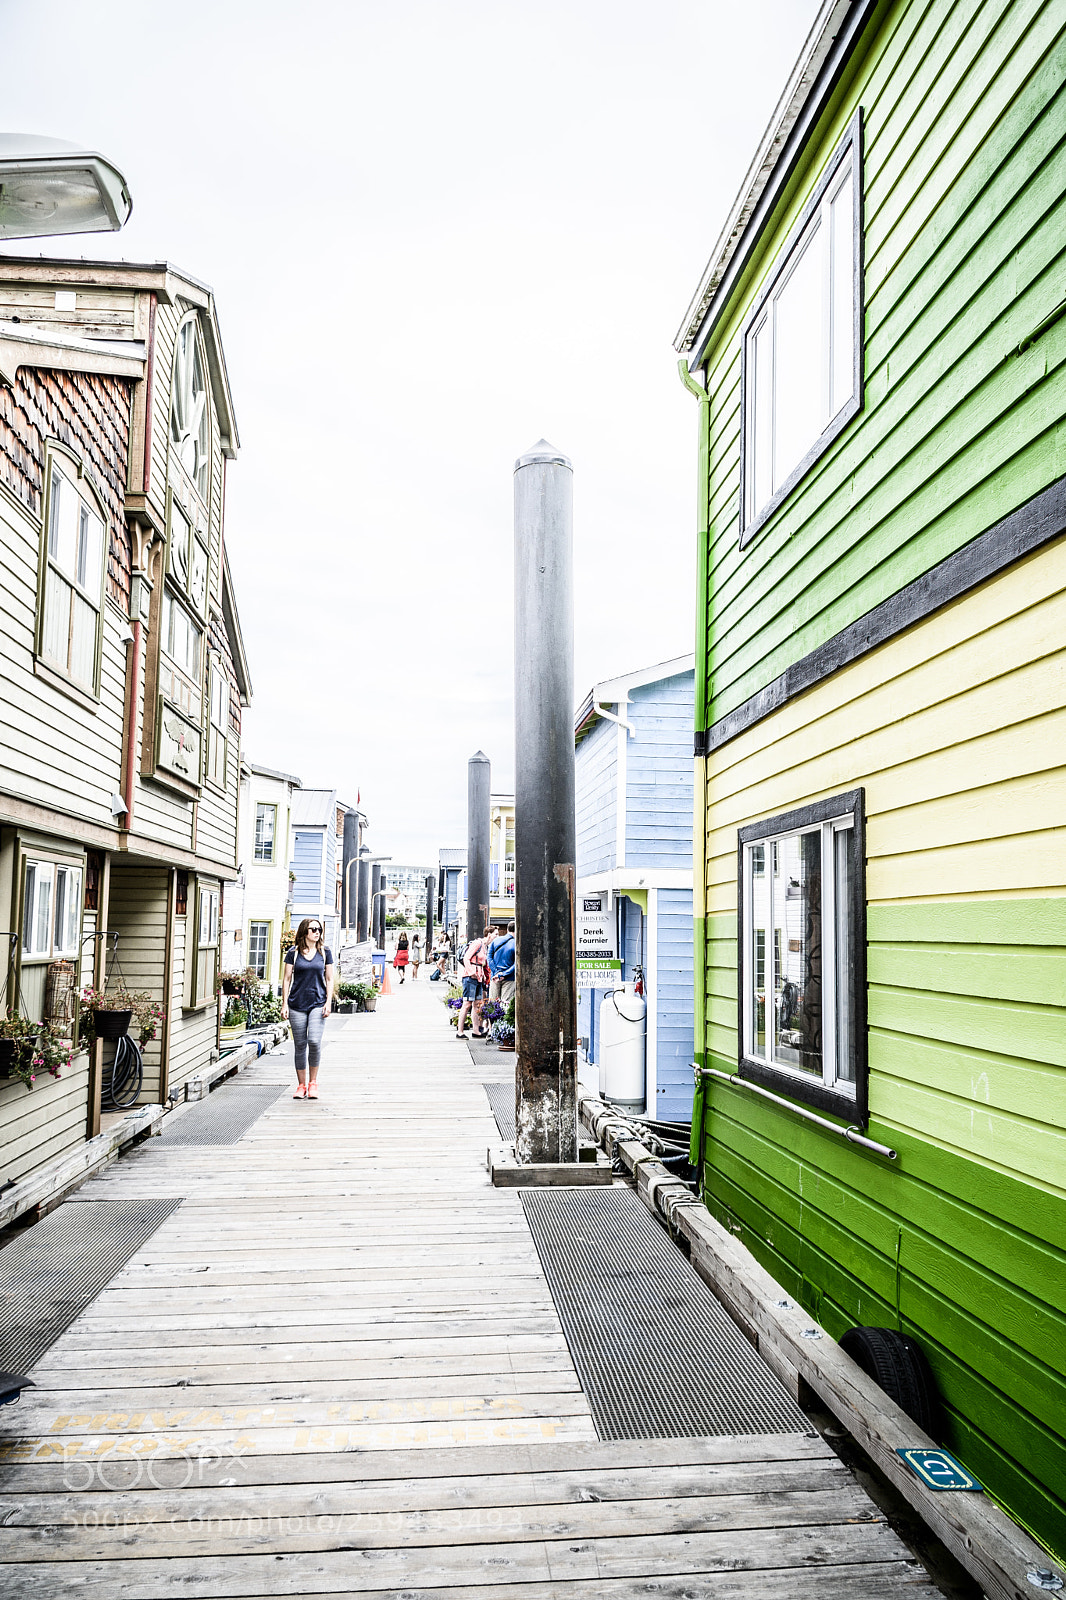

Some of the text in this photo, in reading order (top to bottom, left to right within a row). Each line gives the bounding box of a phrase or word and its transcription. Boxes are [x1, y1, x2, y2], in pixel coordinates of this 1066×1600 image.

[50, 1398, 525, 1432] PRIVATE HOMES
[0, 1437, 203, 1459] ENJOY
[293, 1422, 566, 1448] RESPECT
[923, 1459, 954, 1476] C1
